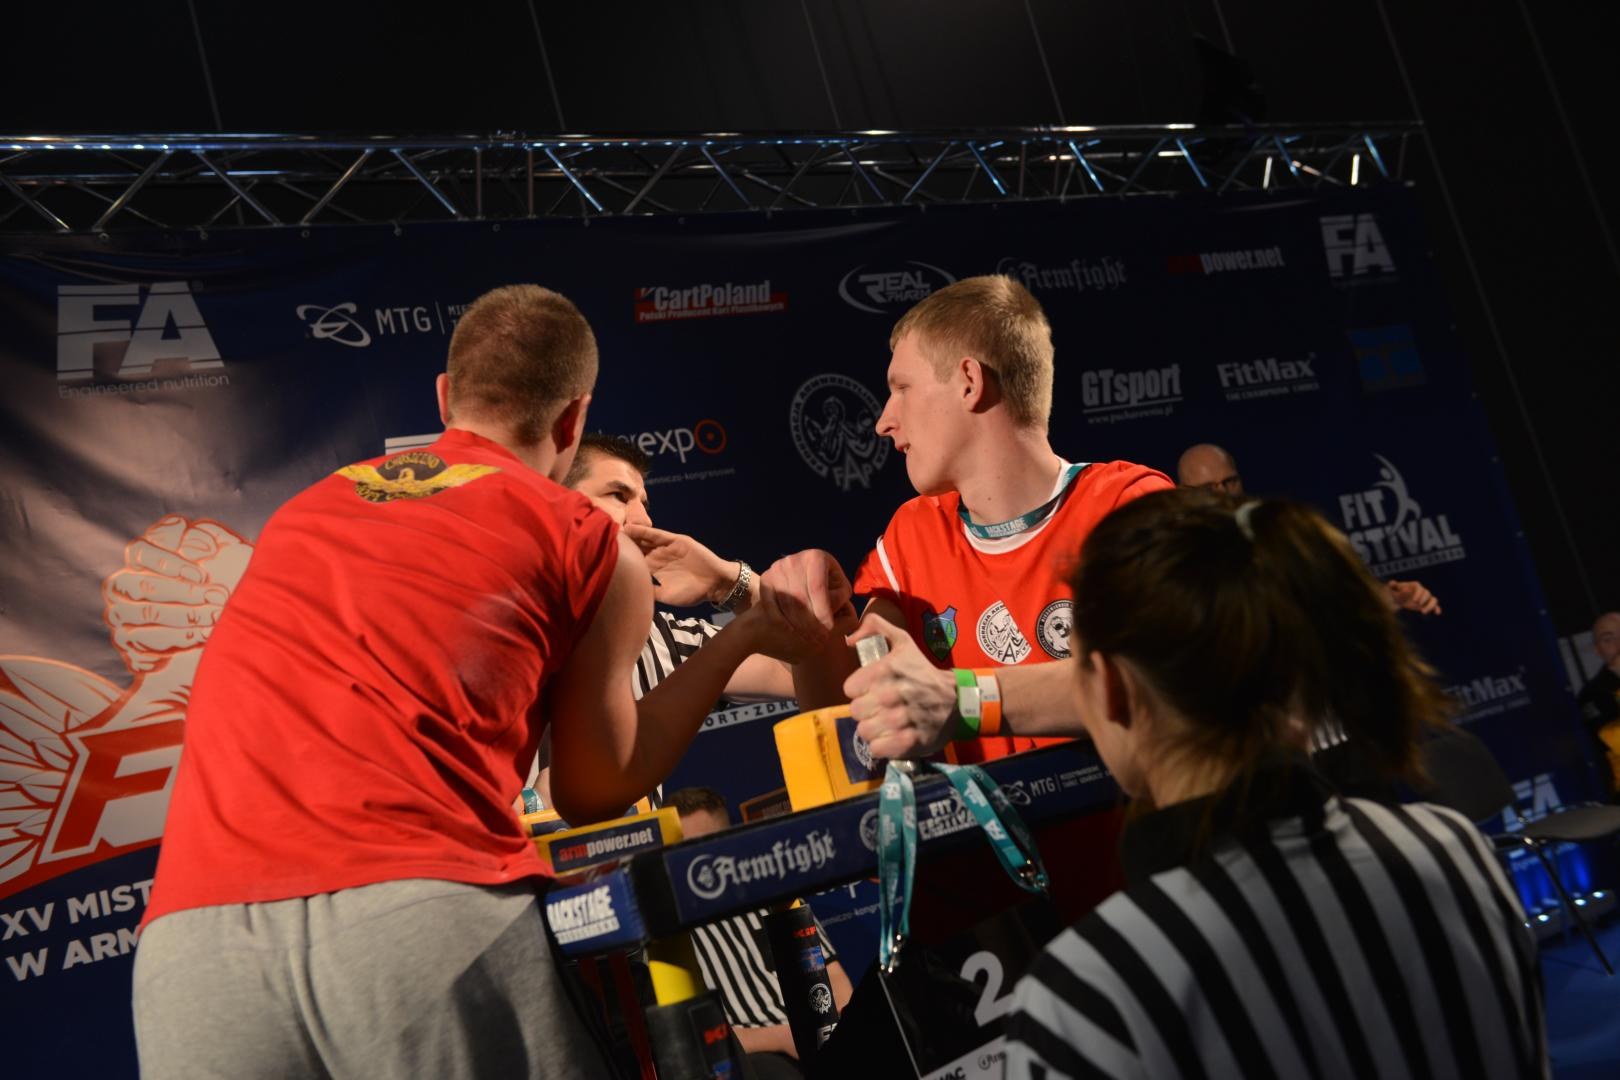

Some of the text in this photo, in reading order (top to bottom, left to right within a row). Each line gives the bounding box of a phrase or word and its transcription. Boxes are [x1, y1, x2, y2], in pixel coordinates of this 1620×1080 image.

[1318, 212, 1397, 278] FA
[654, 279, 771, 312] CartPoland
[858, 271, 931, 303] REAL
[57, 281, 225, 381] FA
[375, 305, 432, 336] MTG
[58, 373, 230, 399] Engineered nutrition
[1081, 362, 1184, 408] GTsport
[1216, 356, 1315, 389] FitMax
[832, 449, 872, 491] FAP
[1338, 488, 1387, 530] FIT
[1350, 514, 1462, 566] STIVAL
[1029, 777, 1056, 798] MTG
[928, 798, 956, 818] FIT
[558, 827, 655, 864] armpower.net
[712, 827, 837, 886] Armfight
[0, 902, 56, 942] XV
[5, 947, 49, 982] W
[960, 950, 1013, 1028] 2
